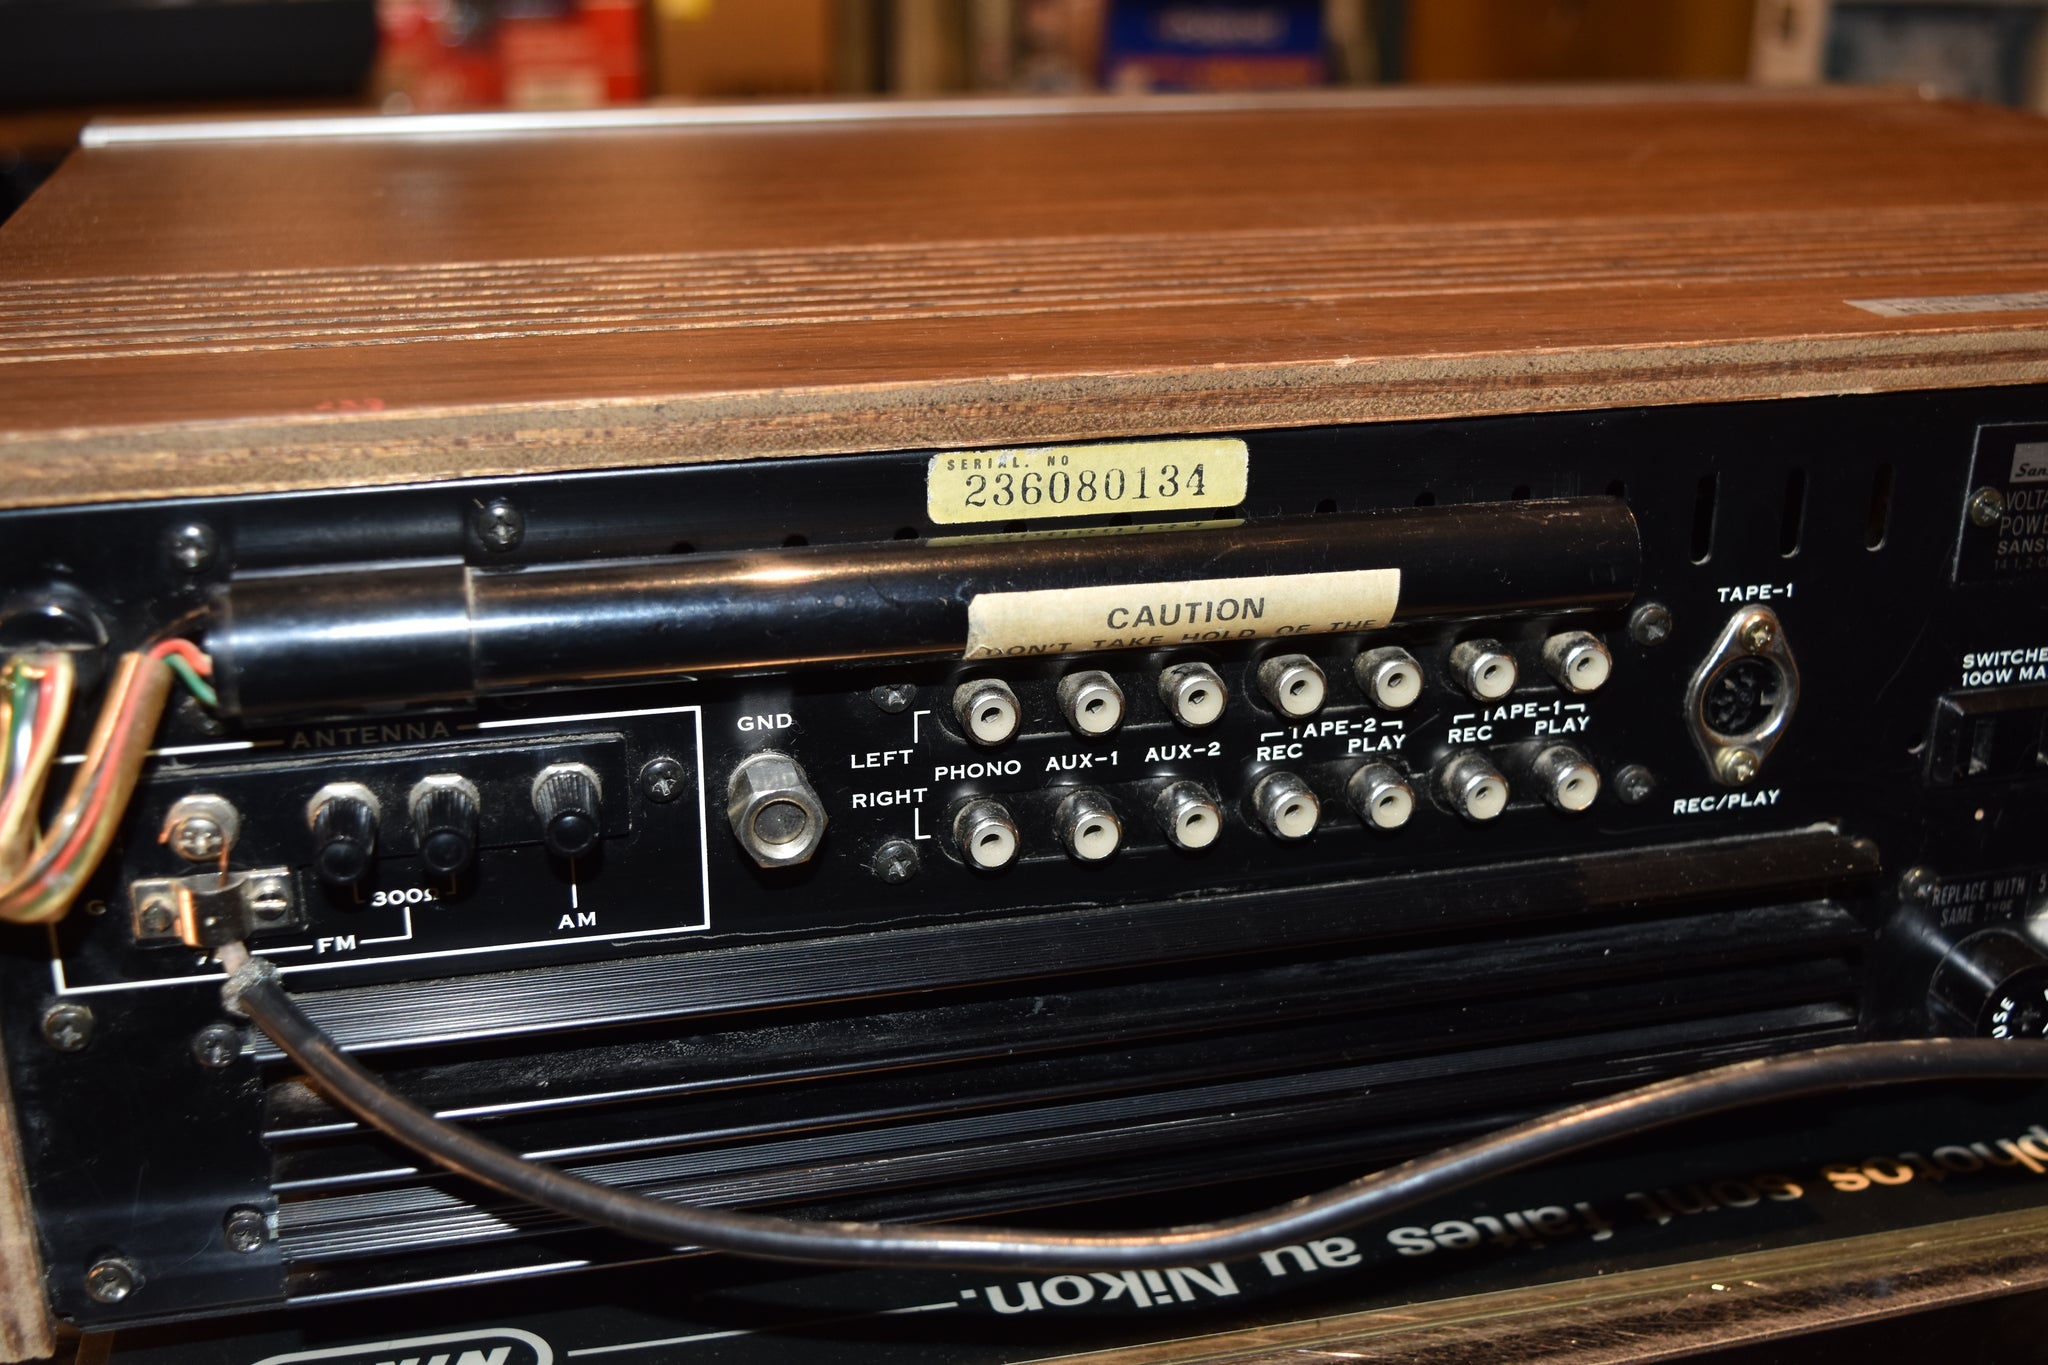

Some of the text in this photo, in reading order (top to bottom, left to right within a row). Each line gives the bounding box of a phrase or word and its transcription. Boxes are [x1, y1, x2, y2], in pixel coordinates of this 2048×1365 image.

[1047, 455, 1069, 467] NO
[965, 463, 1206, 507] 236080134
[1997, 538, 2048, 555] SANS
[1717, 583, 1793, 603] TAPE-1
[1107, 597, 1265, 630] CAUTION
[1092, 634, 1162, 648] TAKE
[1181, 628, 1257, 643] HOLD
[1275, 624, 1311, 635] OF
[1330, 619, 1378, 631] THE
[1962, 664, 2048, 687] 100W MA
[737, 713, 793, 732] GND
[1534, 715, 1591, 736] PLAY
[291, 721, 450, 748] ANTENNA
[1348, 733, 1406, 754] PLAY
[1448, 725, 1493, 744] REC
[851, 749, 914, 769] LEFT
[1045, 750, 1119, 772] AUX-1
[1144, 741, 1221, 762] AUX-2
[1257, 743, 1303, 762] REC
[934, 759, 1022, 781] PHONO
[852, 787, 928, 809] RIGHT
[1673, 789, 1780, 815] REC/PLAY
[1932, 876, 2026, 907] REPLACE WITH
[557, 912, 597, 930] AM
[1940, 906, 1975, 927] SAME
[318, 935, 356, 953] FM
[1992, 996, 2015, 1039] USE
[1386, 1201, 1614, 1256] faites
[1259, 1236, 1363, 1277] au
[961, 1262, 1240, 1314] Nikon.
